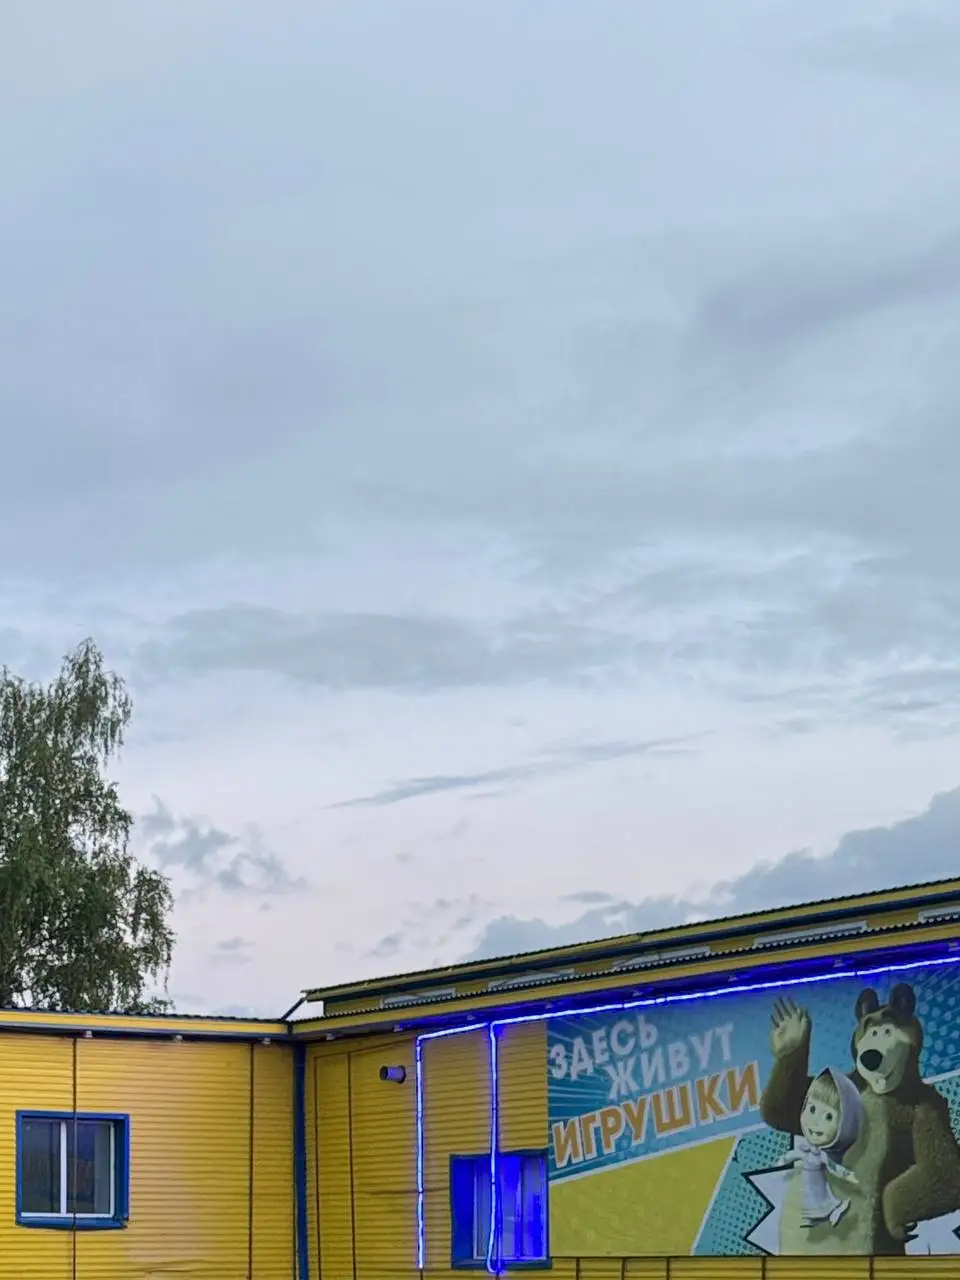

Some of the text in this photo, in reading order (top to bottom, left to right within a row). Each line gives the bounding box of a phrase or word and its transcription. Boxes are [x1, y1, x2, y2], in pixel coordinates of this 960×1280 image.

[550, 1015, 658, 1081] ЗДЕСЬ
[605, 1022, 735, 1099] ЖИВУТ
[552, 1060, 760, 1169] ИГРУШКИ
